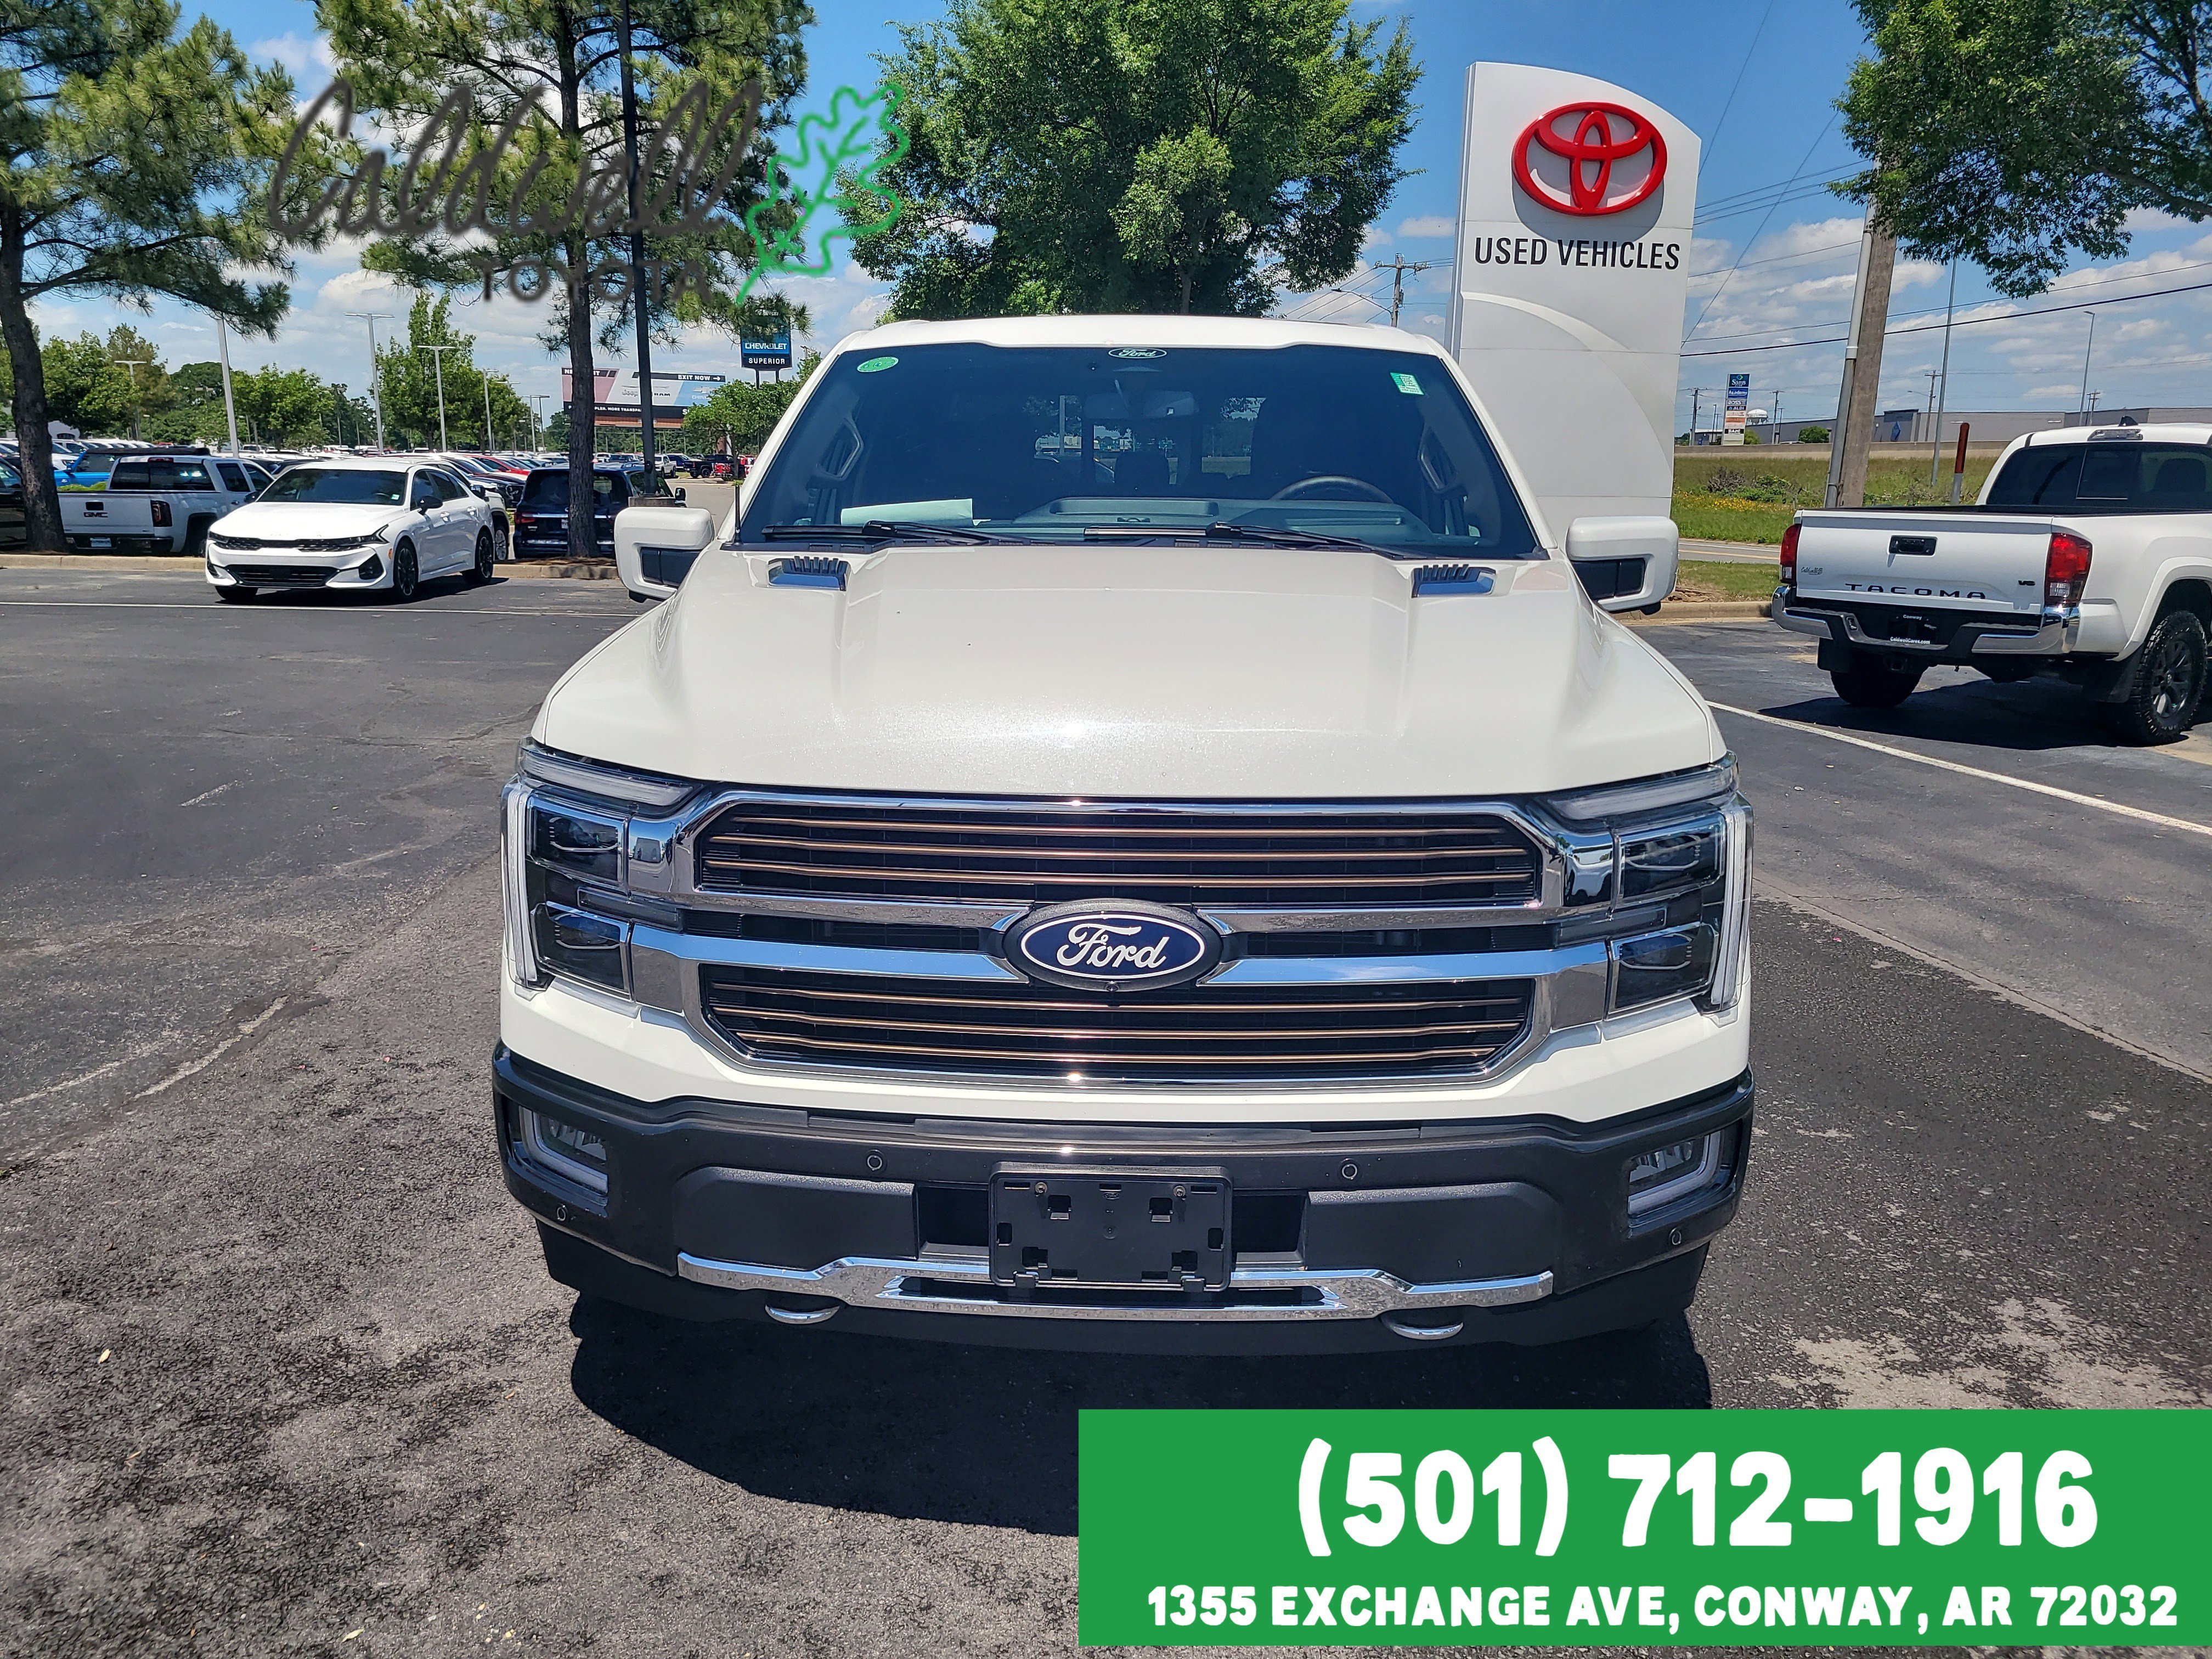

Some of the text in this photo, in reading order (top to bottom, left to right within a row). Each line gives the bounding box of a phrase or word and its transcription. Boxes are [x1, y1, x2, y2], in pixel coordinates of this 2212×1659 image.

[1475, 237, 1680, 270] USED VEHICLES
[1119, 348, 1156, 357] Ford
[1845, 583, 1986, 599] TACOMA
[1890, 636, 1931, 645] CaldwellCares.com
[1057, 923, 1170, 968] Ford
